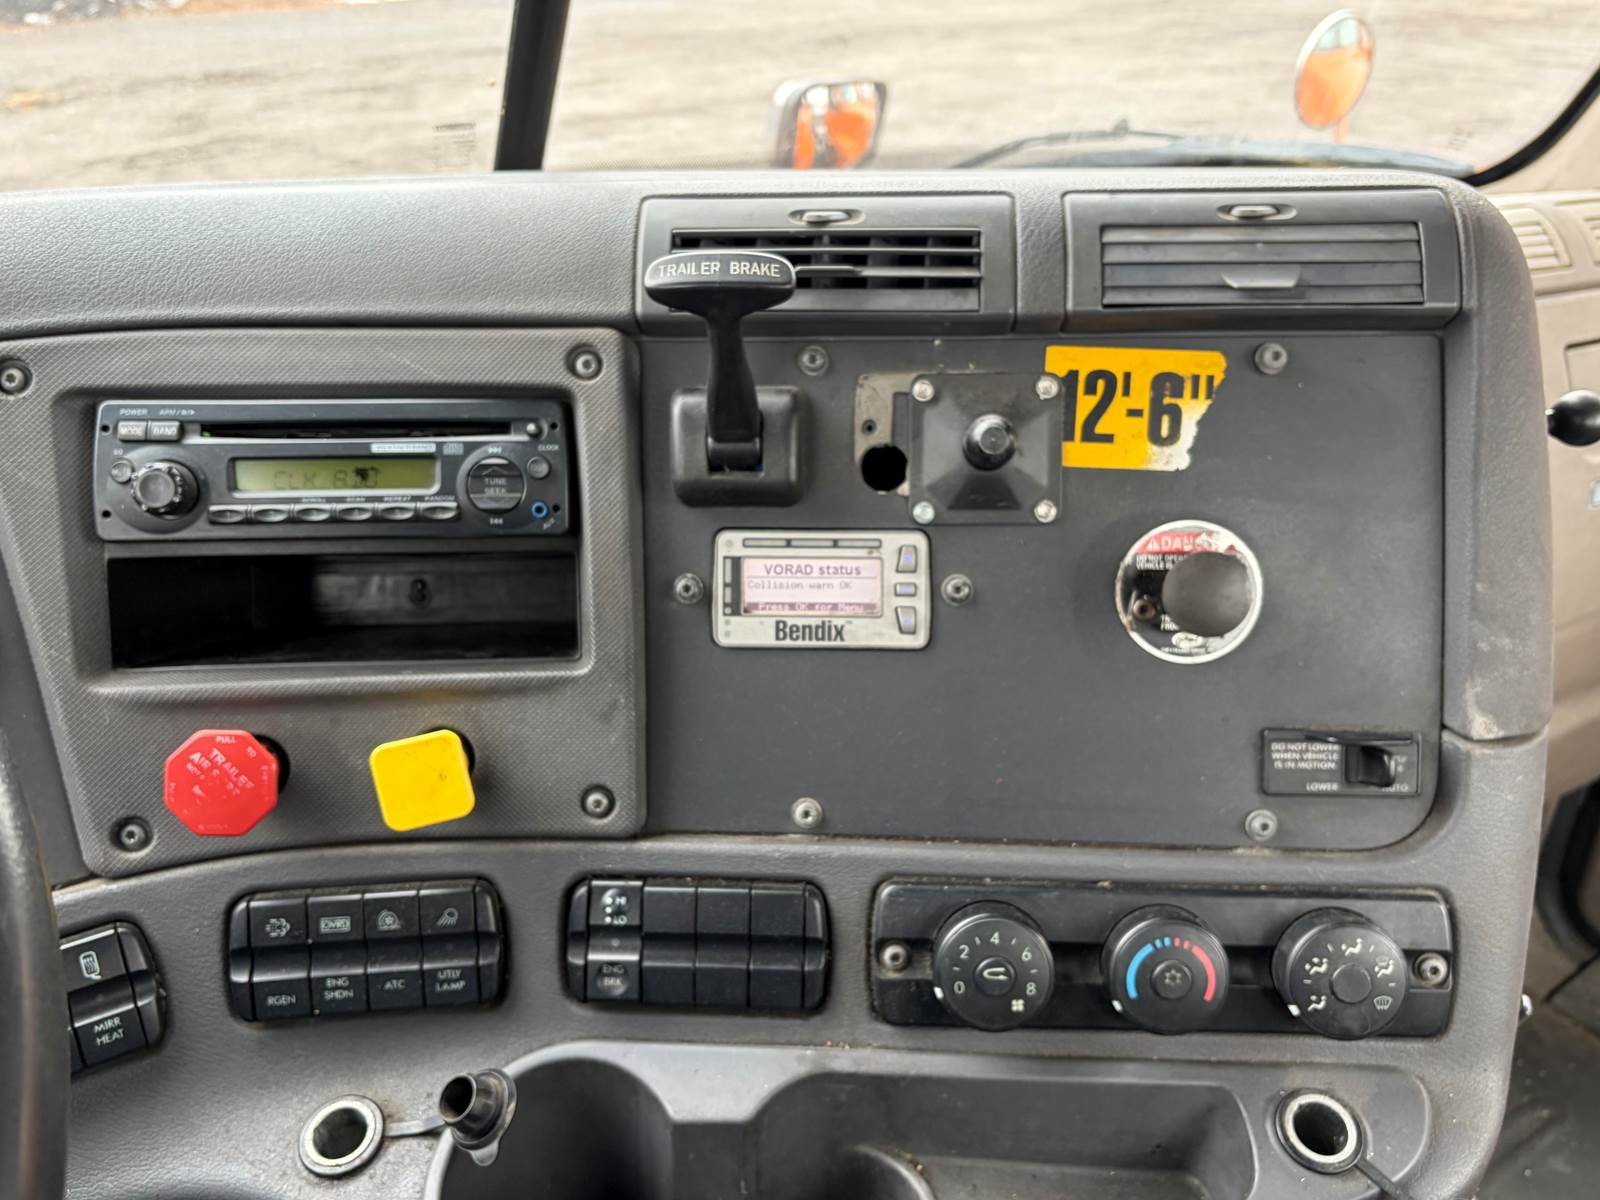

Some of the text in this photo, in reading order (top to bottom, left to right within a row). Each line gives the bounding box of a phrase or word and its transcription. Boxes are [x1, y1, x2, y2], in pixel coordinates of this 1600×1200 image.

[658, 261, 782, 278] TRAILER BRAKE
[484, 477, 507, 486] TUNE
[763, 563, 862, 576] VORAD status
[747, 580, 853, 590] Collision warn OK
[774, 619, 846, 642] Bendix
[1271, 742, 1340, 751] DO NOT LOWER
[1271, 751, 1340, 760] WHEN VEHICLE
[1274, 760, 1336, 769] IS IN MOTION
[1306, 781, 1339, 791] LOWER
[989, 931, 1000, 945] 4
[959, 944, 970, 959] 2
[1021, 946, 1032, 962] 6
[325, 977, 350, 988] ENG
[384, 979, 406, 991] ATC
[435, 979, 466, 992] LAMP
[953, 980, 966, 995] 0
[1025, 981, 1037, 996] 8
[266, 994, 297, 1007] RGEN
[323, 988, 355, 1001] SHDN
[94, 1016, 122, 1033] MIRR
